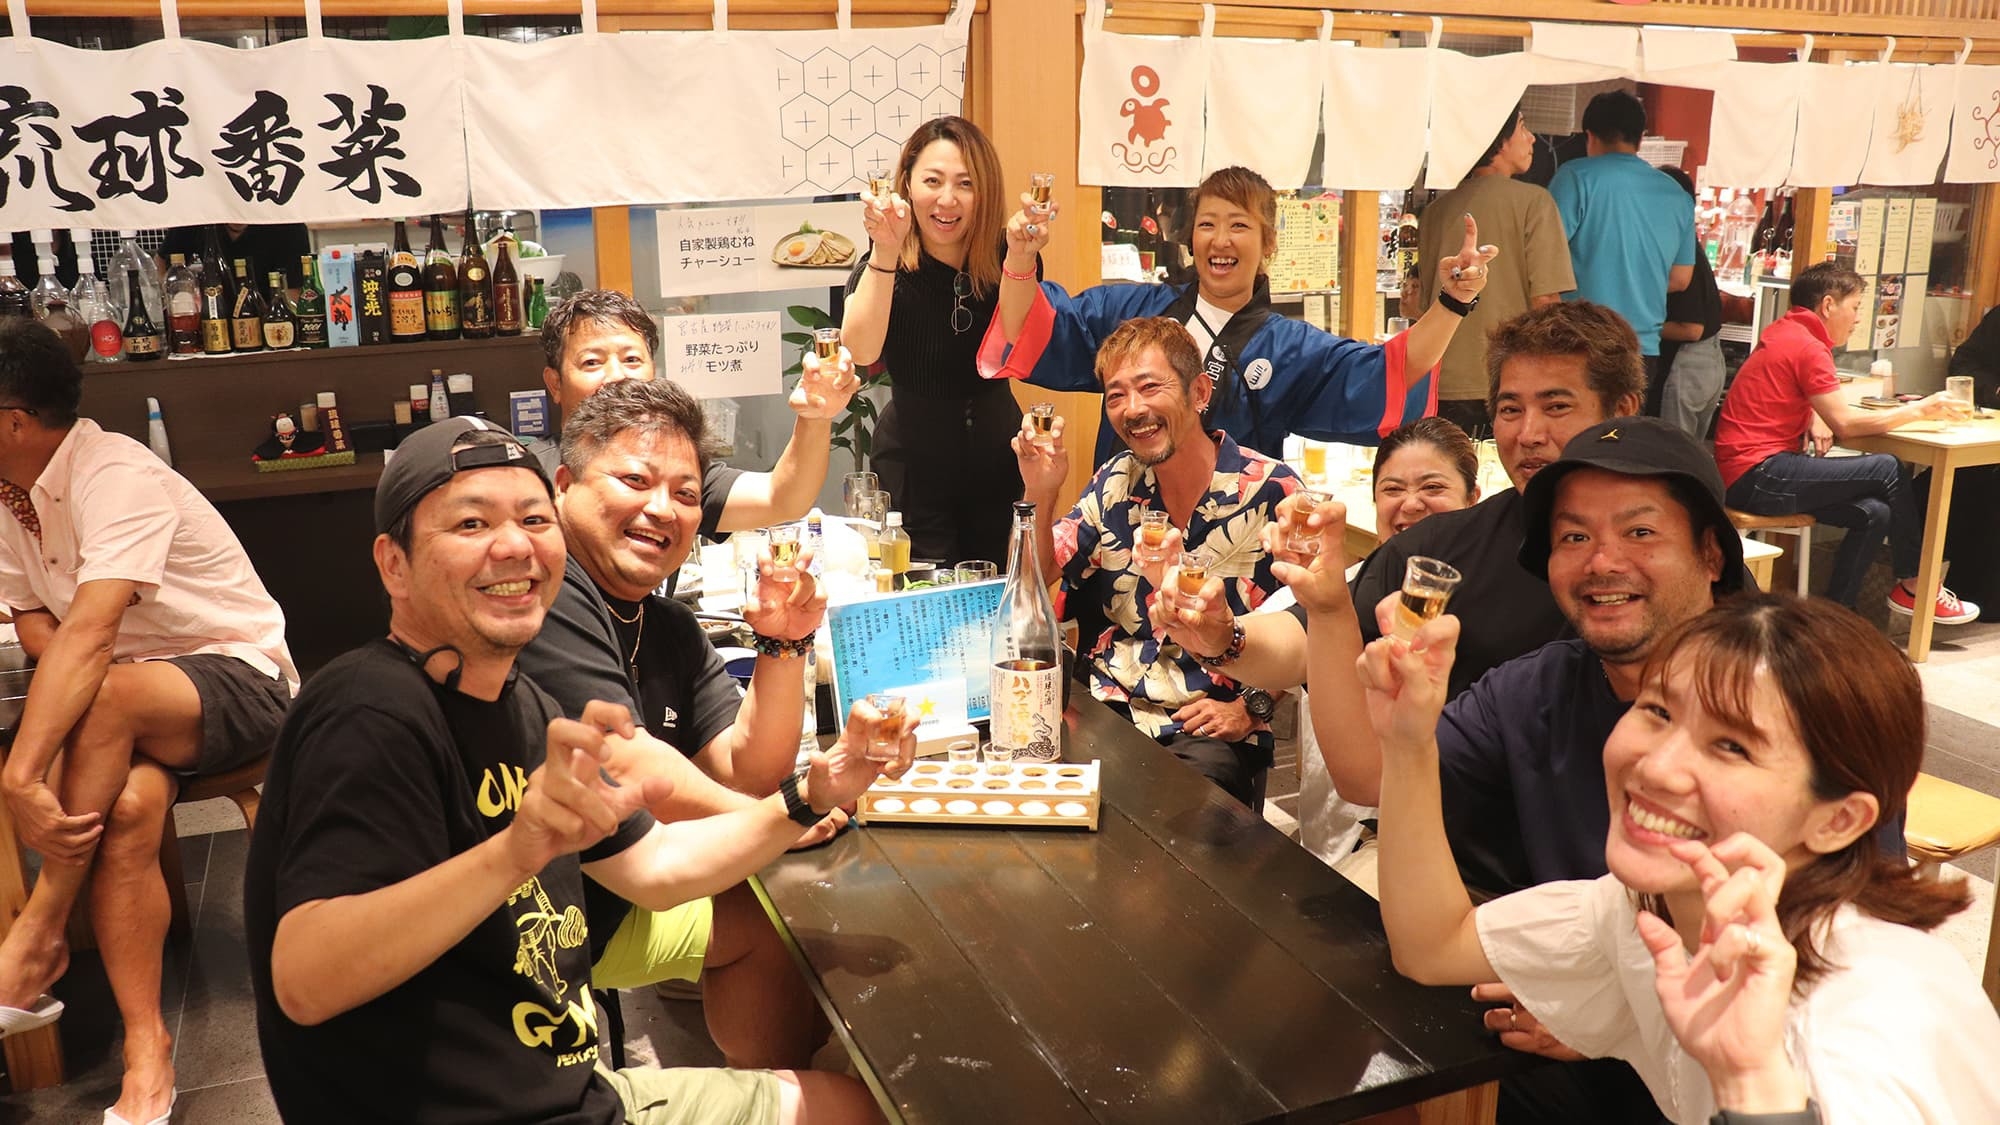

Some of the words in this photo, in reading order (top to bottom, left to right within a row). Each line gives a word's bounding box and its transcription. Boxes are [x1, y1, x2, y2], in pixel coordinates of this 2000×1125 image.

[0, 85, 421, 212] 琉球番菜
[680, 235, 755, 252] 自家製鶏むね
[680, 255, 755, 270] チャーシュー
[362, 279, 382, 317] 沖之光
[685, 340, 760, 357] 野菜たっぷり
[705, 359, 743, 373] モツ煮
[476, 762, 529, 818] ON
